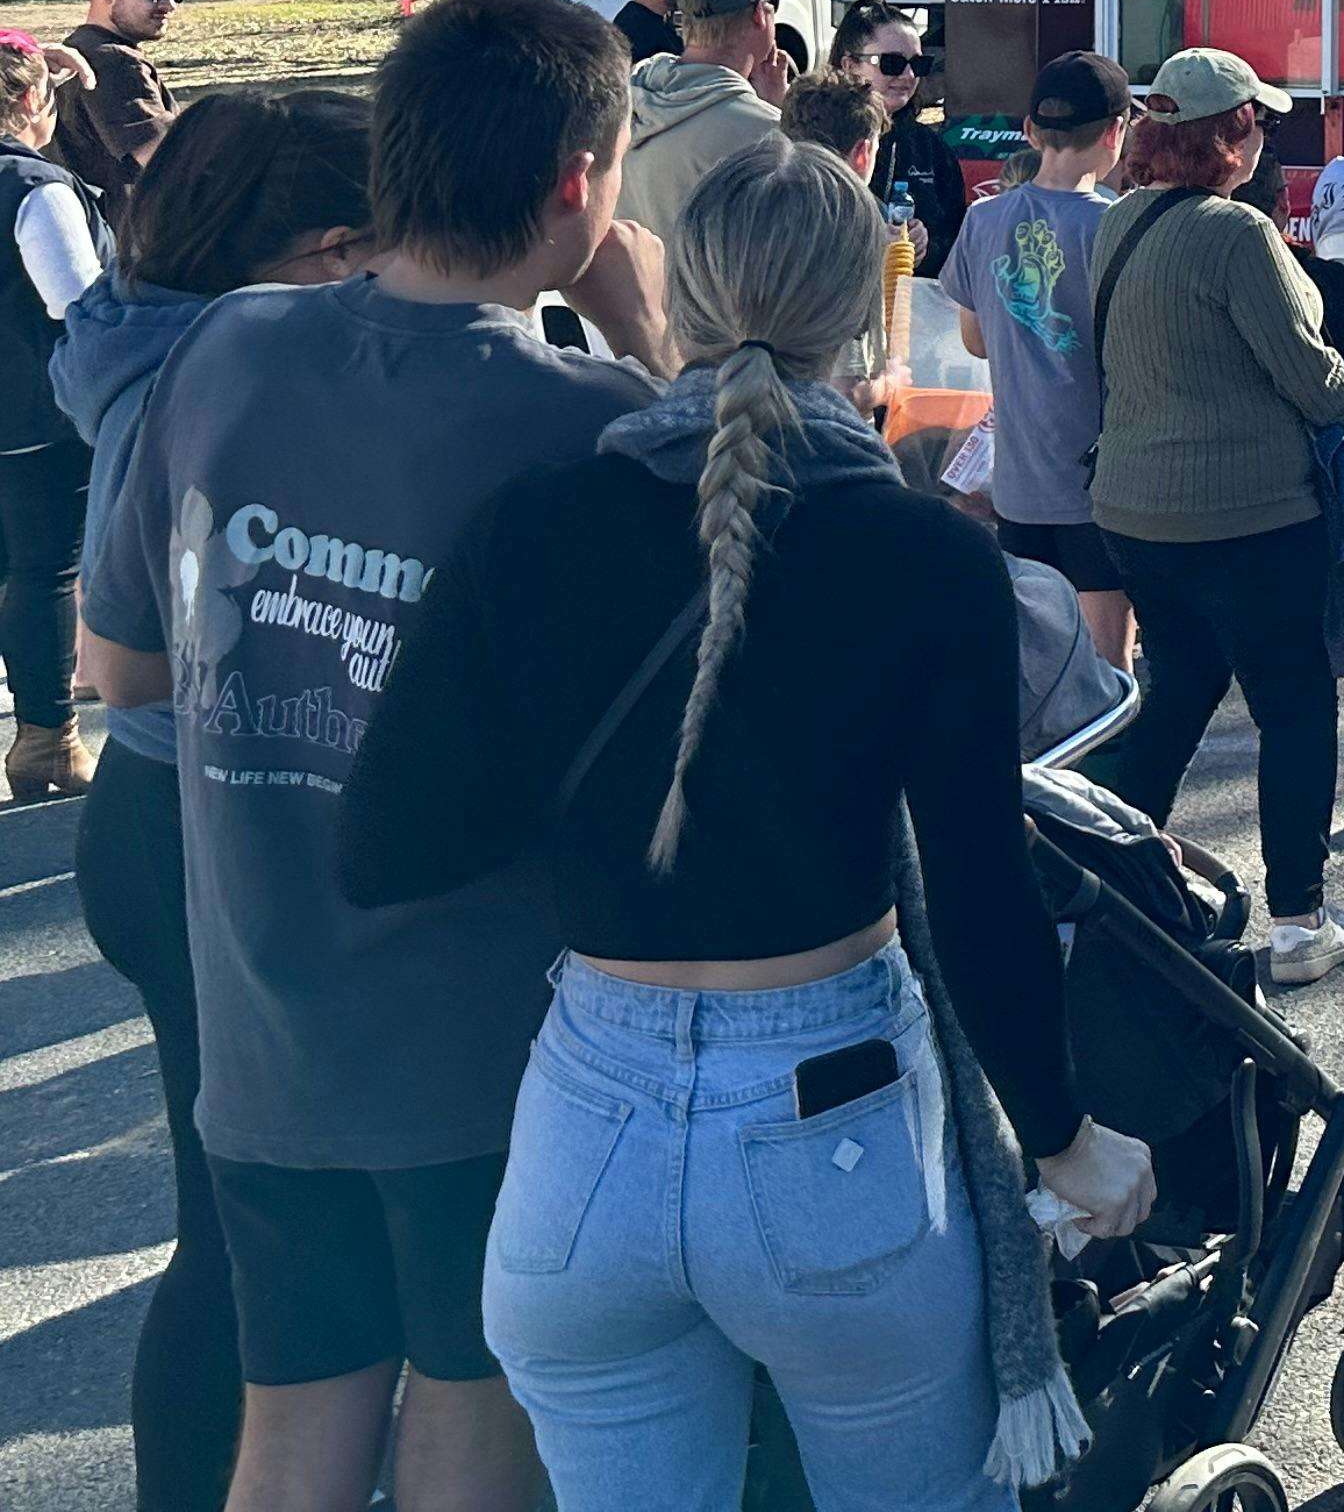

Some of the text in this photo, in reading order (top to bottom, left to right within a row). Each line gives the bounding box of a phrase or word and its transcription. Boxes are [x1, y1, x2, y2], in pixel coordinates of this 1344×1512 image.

[226, 503, 437, 603] Comm
[251, 574, 343, 639] embrace
[230, 770, 265, 785] LIFE
[267, 770, 304, 785] NEW
